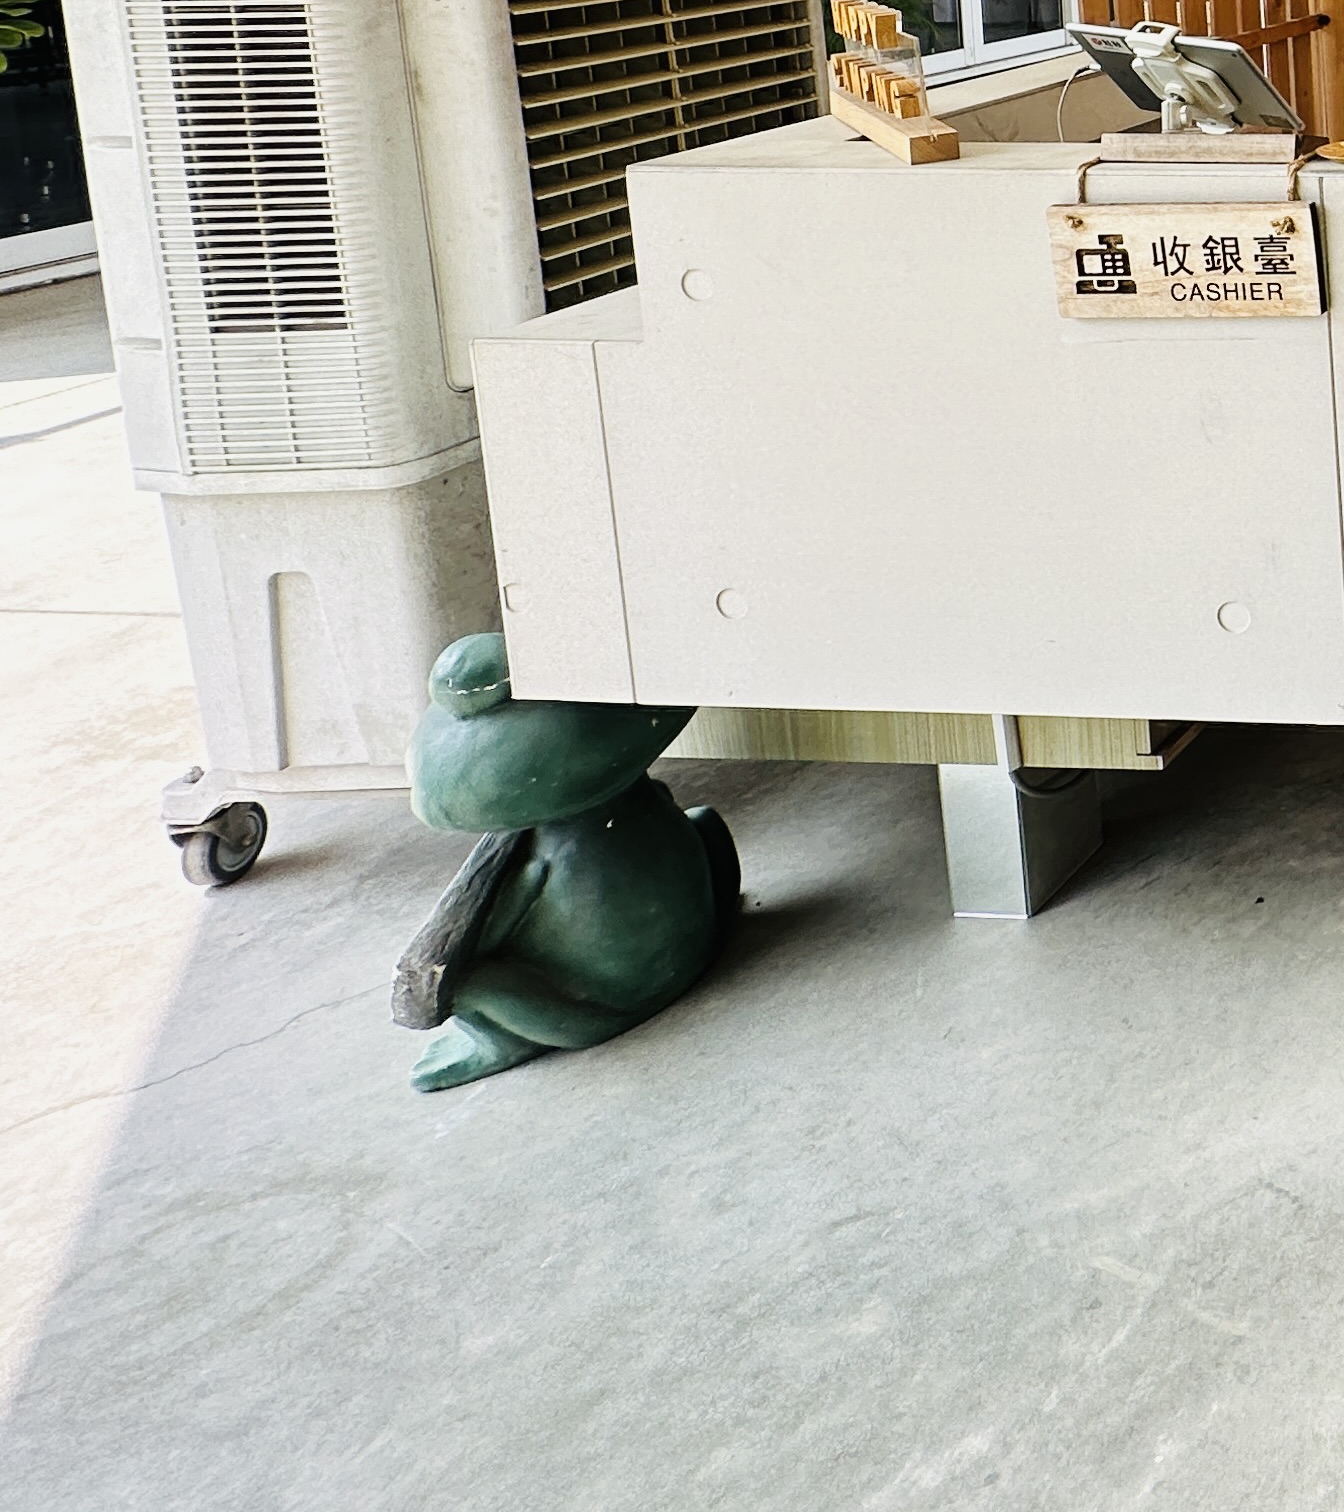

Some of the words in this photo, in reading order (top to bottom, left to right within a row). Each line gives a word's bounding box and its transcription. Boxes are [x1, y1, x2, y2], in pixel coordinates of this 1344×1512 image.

[1151, 234, 1297, 276] 收銀臺
[1170, 282, 1284, 302] CASHIER
